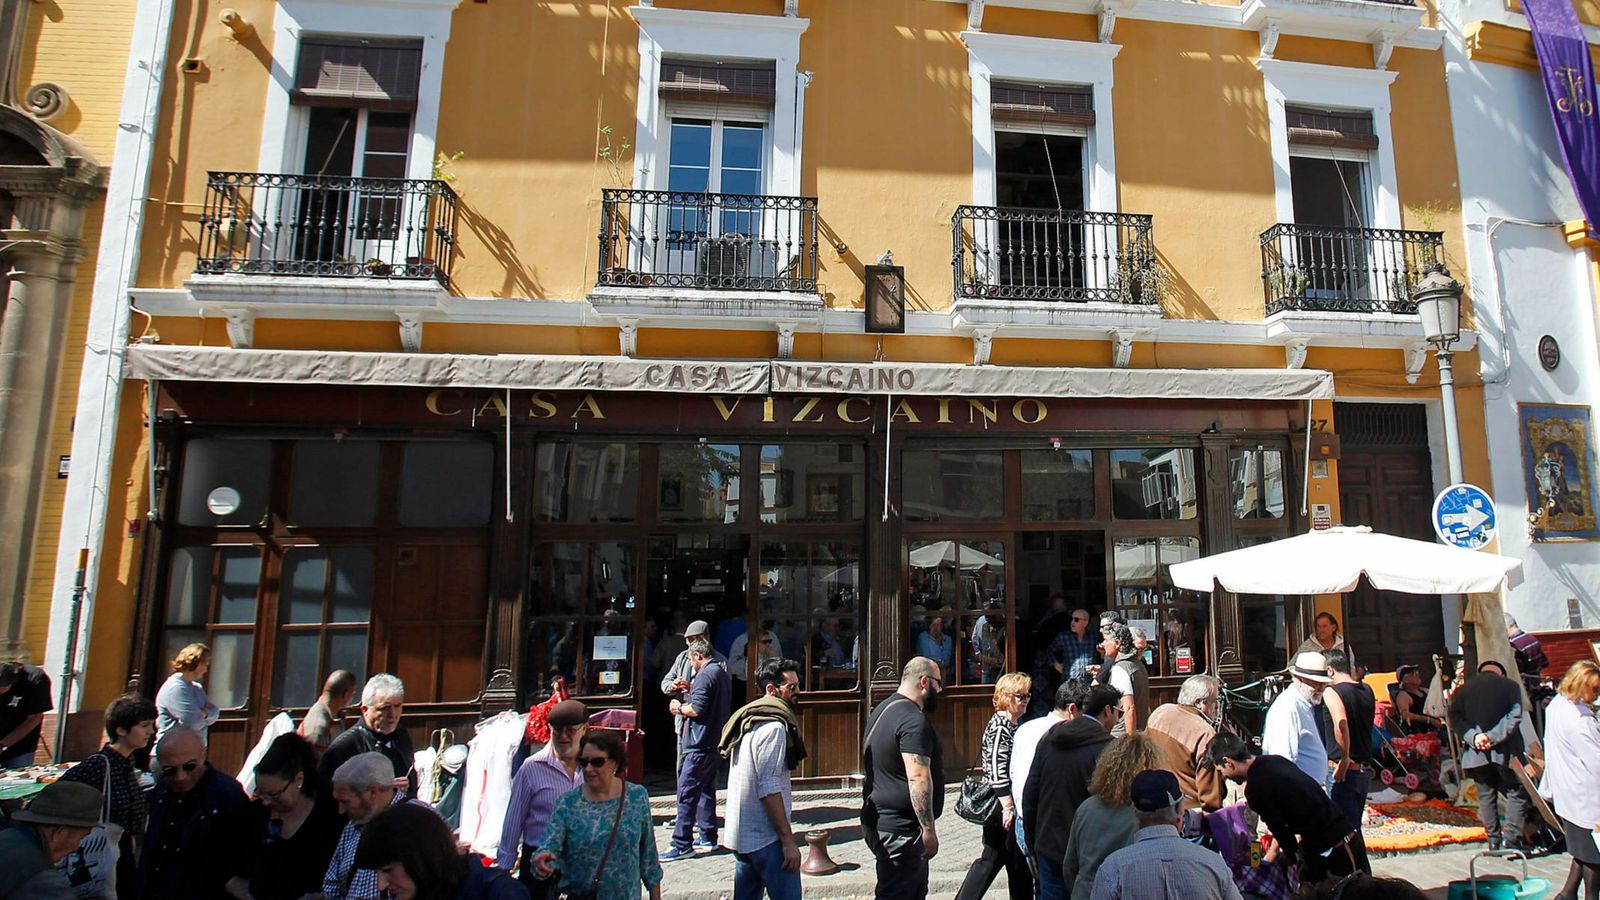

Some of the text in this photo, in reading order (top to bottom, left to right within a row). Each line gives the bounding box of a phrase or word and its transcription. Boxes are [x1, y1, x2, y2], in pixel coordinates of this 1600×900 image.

[646, 365, 915, 390] CASA VIZCAINO
[425, 390, 1048, 424] CASA VIZCAINO
[1310, 419, 1328, 432] 27
